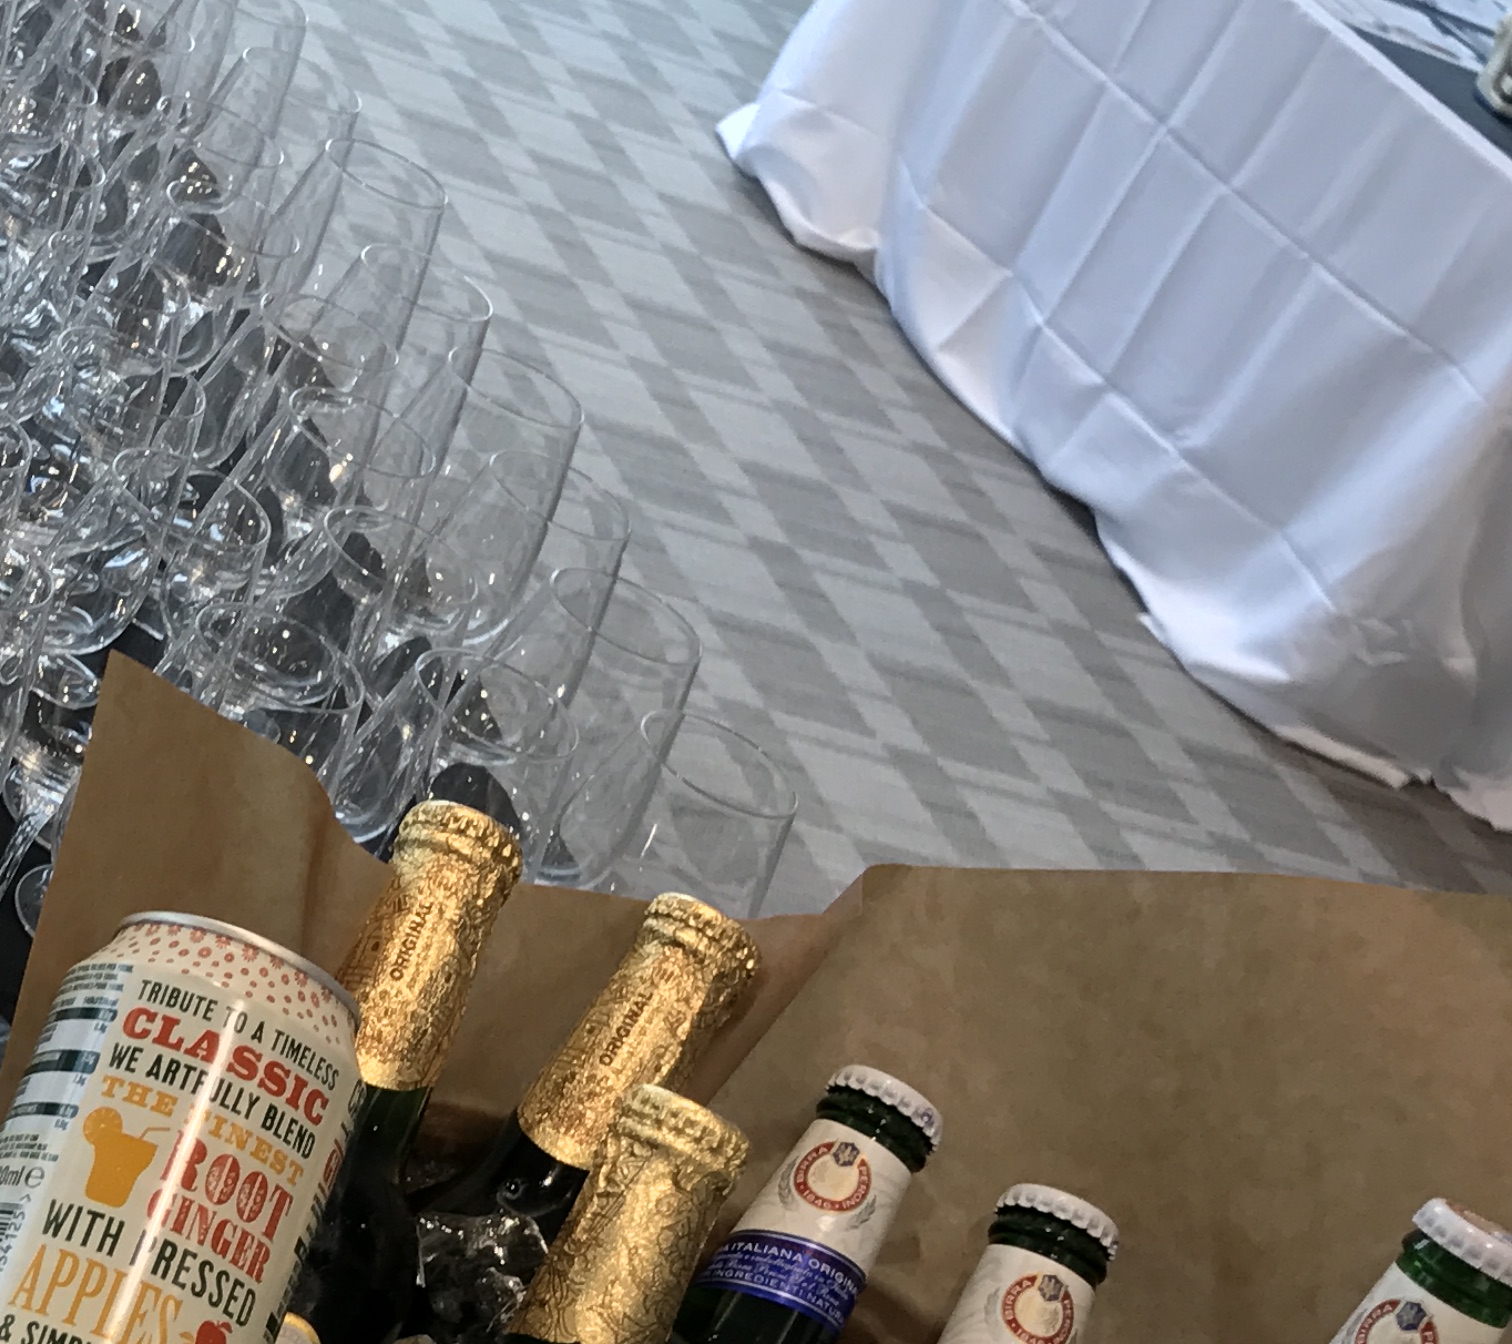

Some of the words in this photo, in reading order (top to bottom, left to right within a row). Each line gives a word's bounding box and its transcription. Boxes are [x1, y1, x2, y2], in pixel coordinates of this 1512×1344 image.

[390, 902, 434, 981] ORIGINAL
[122, 1006, 330, 1126] CLASSIC
[138, 979, 218, 1022] TRIBUTE
[224, 1005, 248, 1035] TO
[251, 1020, 266, 1044] A
[270, 1028, 340, 1091] TIMELESS
[599, 990, 656, 1068] ORIGINAL
[101, 1074, 179, 1118] THE
[108, 1042, 144, 1074] WE
[145, 1053, 261, 1121] ARTFULLY
[260, 1102, 317, 1160] BLEND
[158, 1129, 295, 1243] ROOT
[841, 1165, 871, 1210] PERONI
[42, 1198, 126, 1258] WITH
[128, 1227, 257, 1328] PRESSED
[146, 1186, 272, 1285] GINGER
[731, 1241, 804, 1264] ITALIANA
[808, 1258, 861, 1296] ORIGINA
[713, 1267, 805, 1298] INGREDIENTI
[806, 1292, 846, 1325] NATURA
[1003, 1278, 1033, 1321] BIRRA
